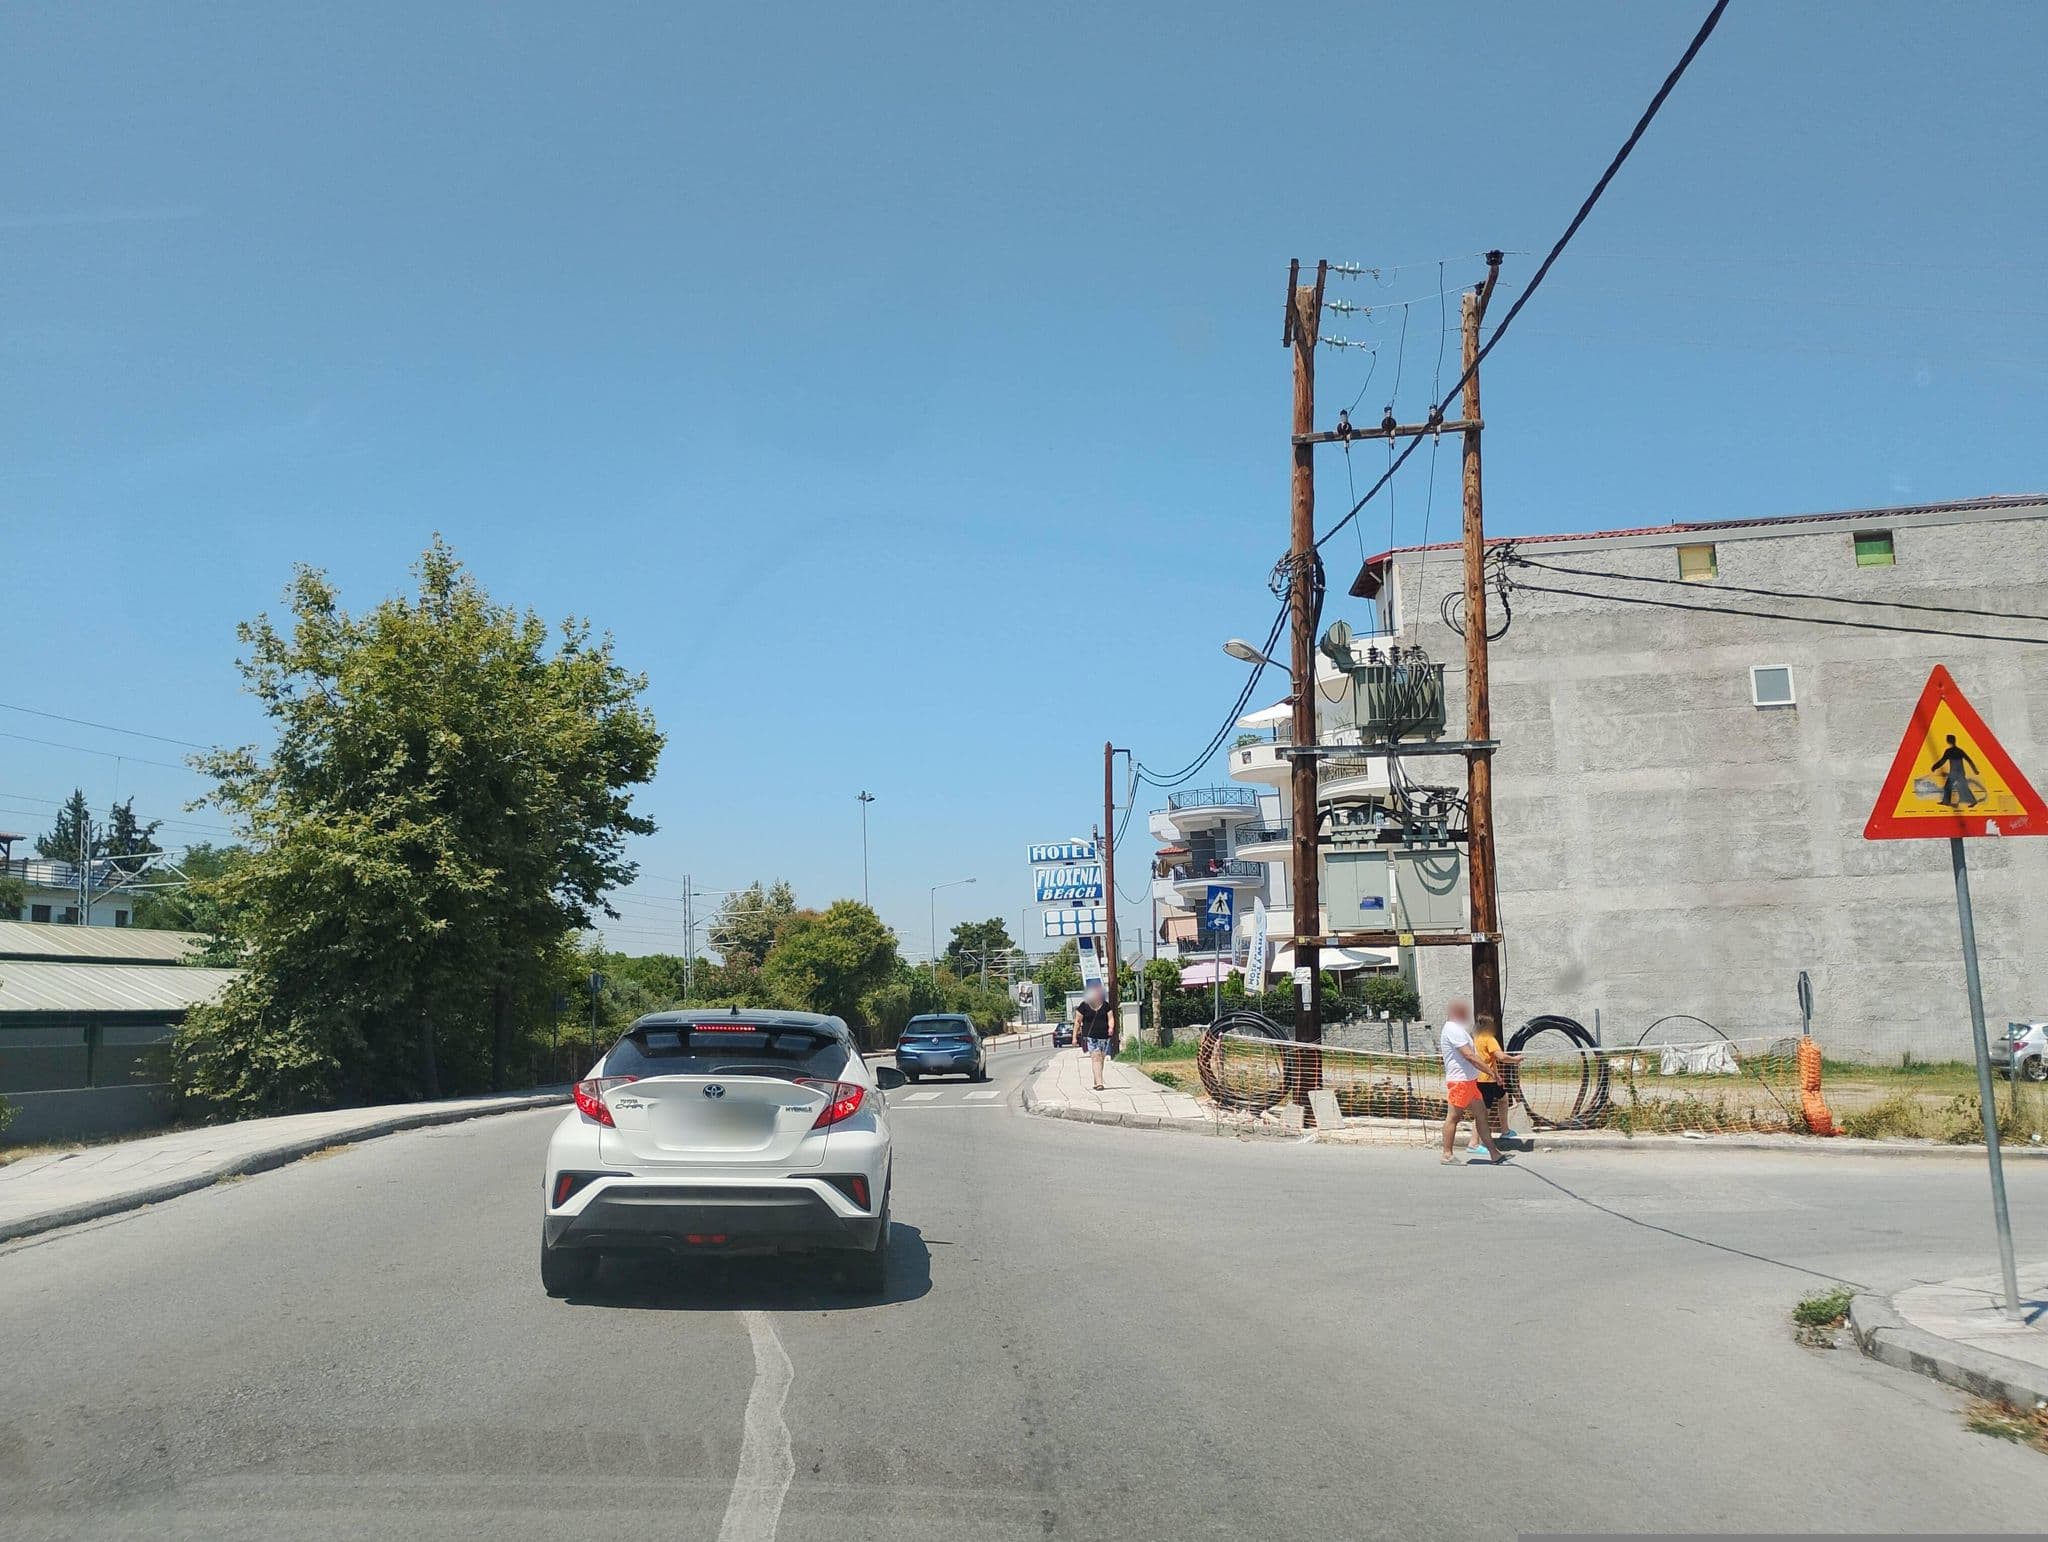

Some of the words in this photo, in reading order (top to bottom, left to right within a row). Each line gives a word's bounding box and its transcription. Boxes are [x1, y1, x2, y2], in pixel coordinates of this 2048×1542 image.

[1032, 844, 1094, 860] HOTEL
[1037, 867, 1101, 887] FILOXENIA
[1042, 887, 1097, 900] BEACH
